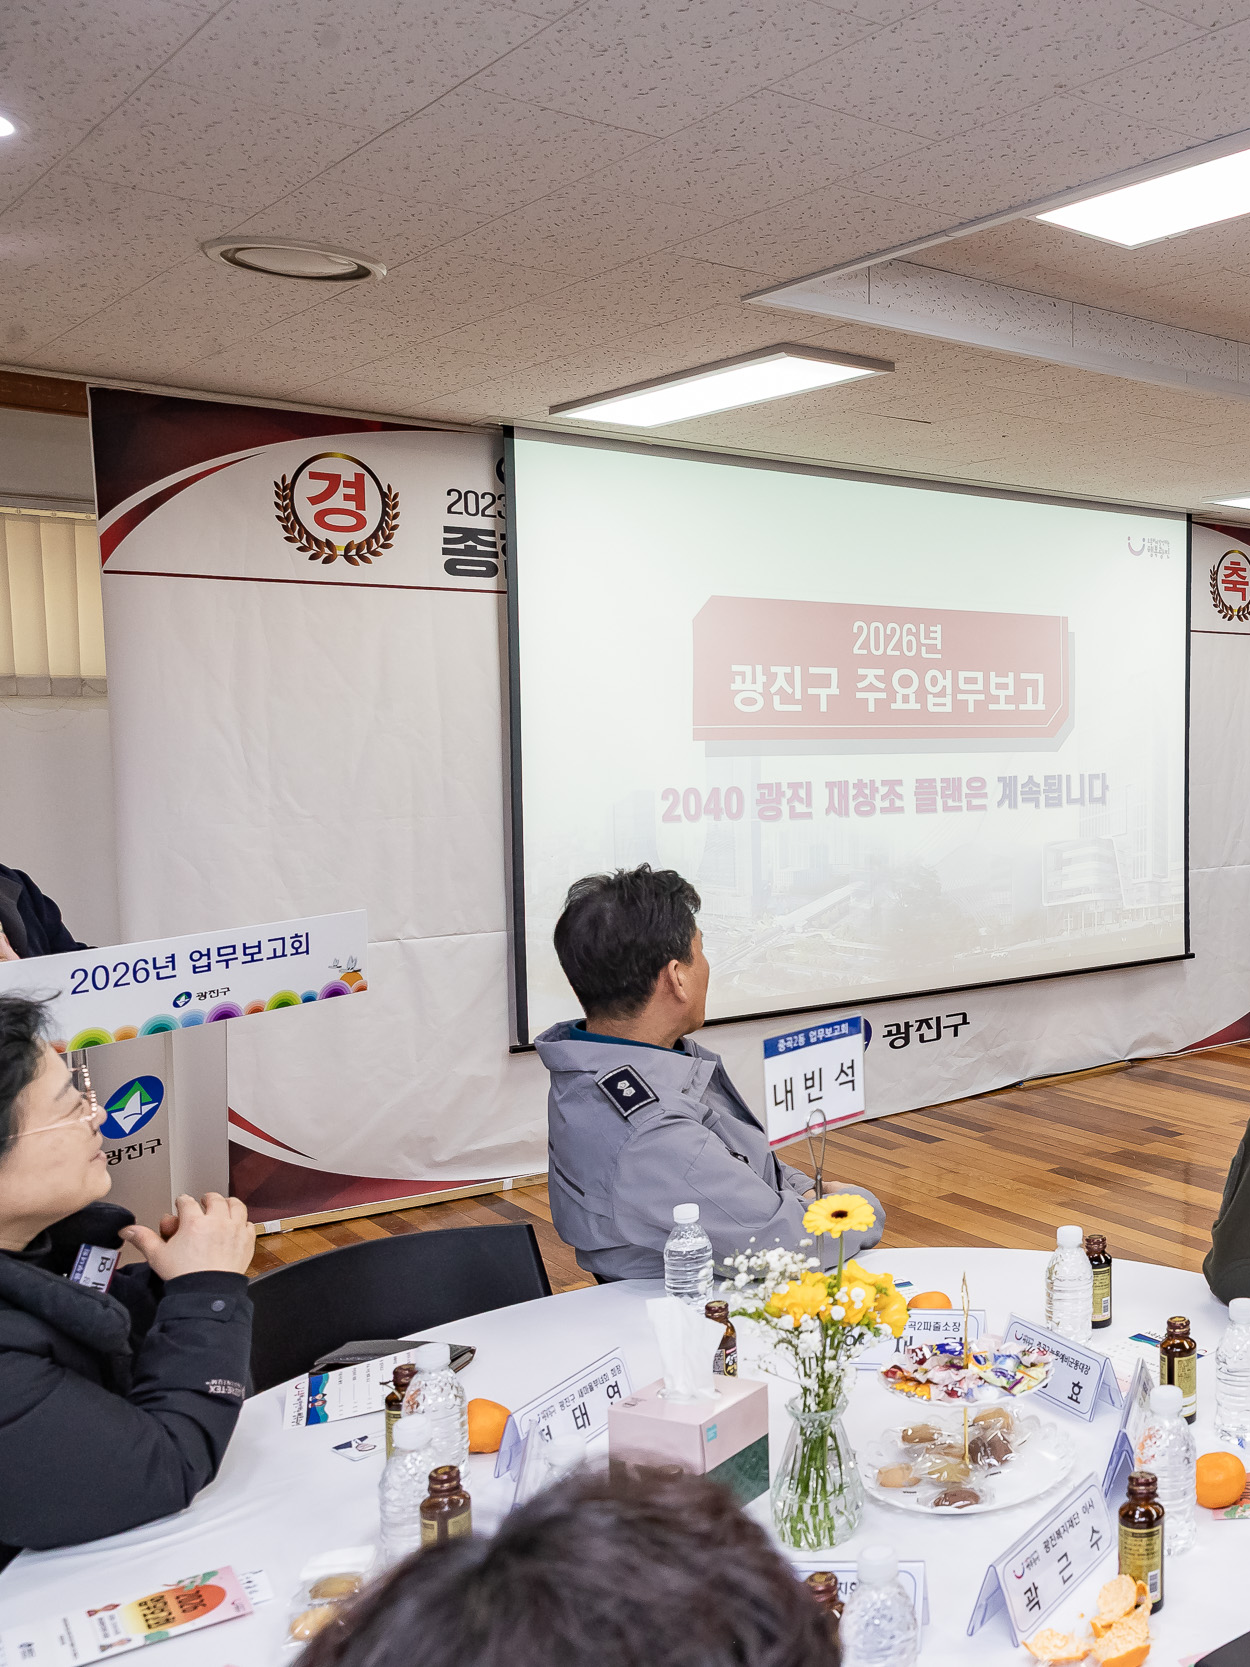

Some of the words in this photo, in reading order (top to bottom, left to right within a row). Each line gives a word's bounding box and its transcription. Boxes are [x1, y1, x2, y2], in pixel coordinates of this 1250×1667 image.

[306, 470, 366, 533] 경
[1221, 561, 1249, 602] 축
[852, 620, 943, 660] 2026년
[729, 663, 841, 714] 광진구
[854, 667, 1047, 714] 주요업무보고
[661, 785, 744, 824] 2040
[755, 780, 814, 823] 광진
[824, 776, 905, 819] 재창조
[913, 774, 988, 813] 플랜은
[996, 772, 1110, 810] 계속됩니다
[70, 953, 178, 996] 2026년
[189, 932, 311, 976] 업무보고회
[196, 986, 231, 1001] 광진구
[808, 1022, 850, 1043] 업무보고회
[882, 1012, 970, 1050] 광진구
[105, 1139, 163, 1166] 광진구
[1042, 1512, 1080, 1554] 광진복지재단
[1081, 1498, 1095, 1515] 이사
